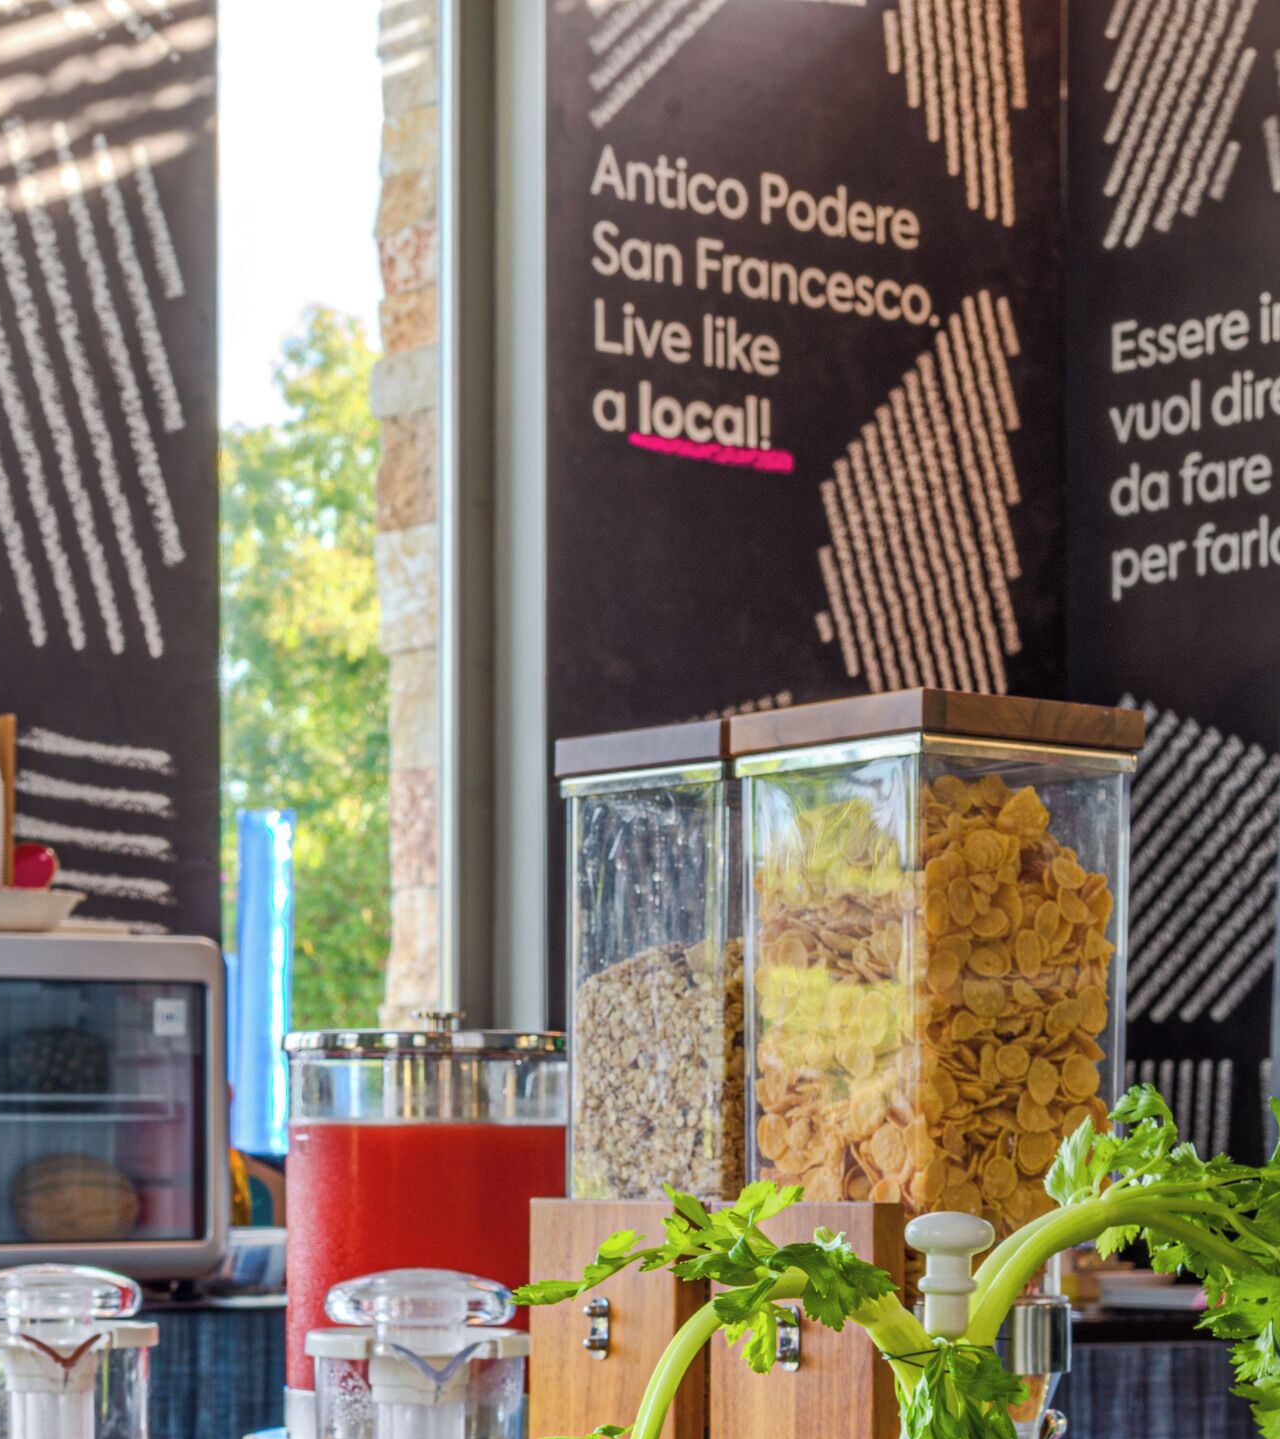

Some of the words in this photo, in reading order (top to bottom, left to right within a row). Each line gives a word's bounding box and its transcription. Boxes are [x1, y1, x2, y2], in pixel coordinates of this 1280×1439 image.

[590, 144, 750, 221] Antico
[760, 172, 921, 250] Podere
[592, 220, 684, 287] San
[696, 236, 941, 328] Francesco.
[594, 298, 693, 363] Live
[703, 313, 782, 377] like
[1111, 319, 1250, 373] Essere
[593, 389, 627, 432] a
[638, 380, 772, 452] local!
[1109, 378, 1201, 444] vuol
[1110, 462, 1169, 517] da
[1179, 451, 1273, 506] fare
[1111, 543, 1187, 602] per
